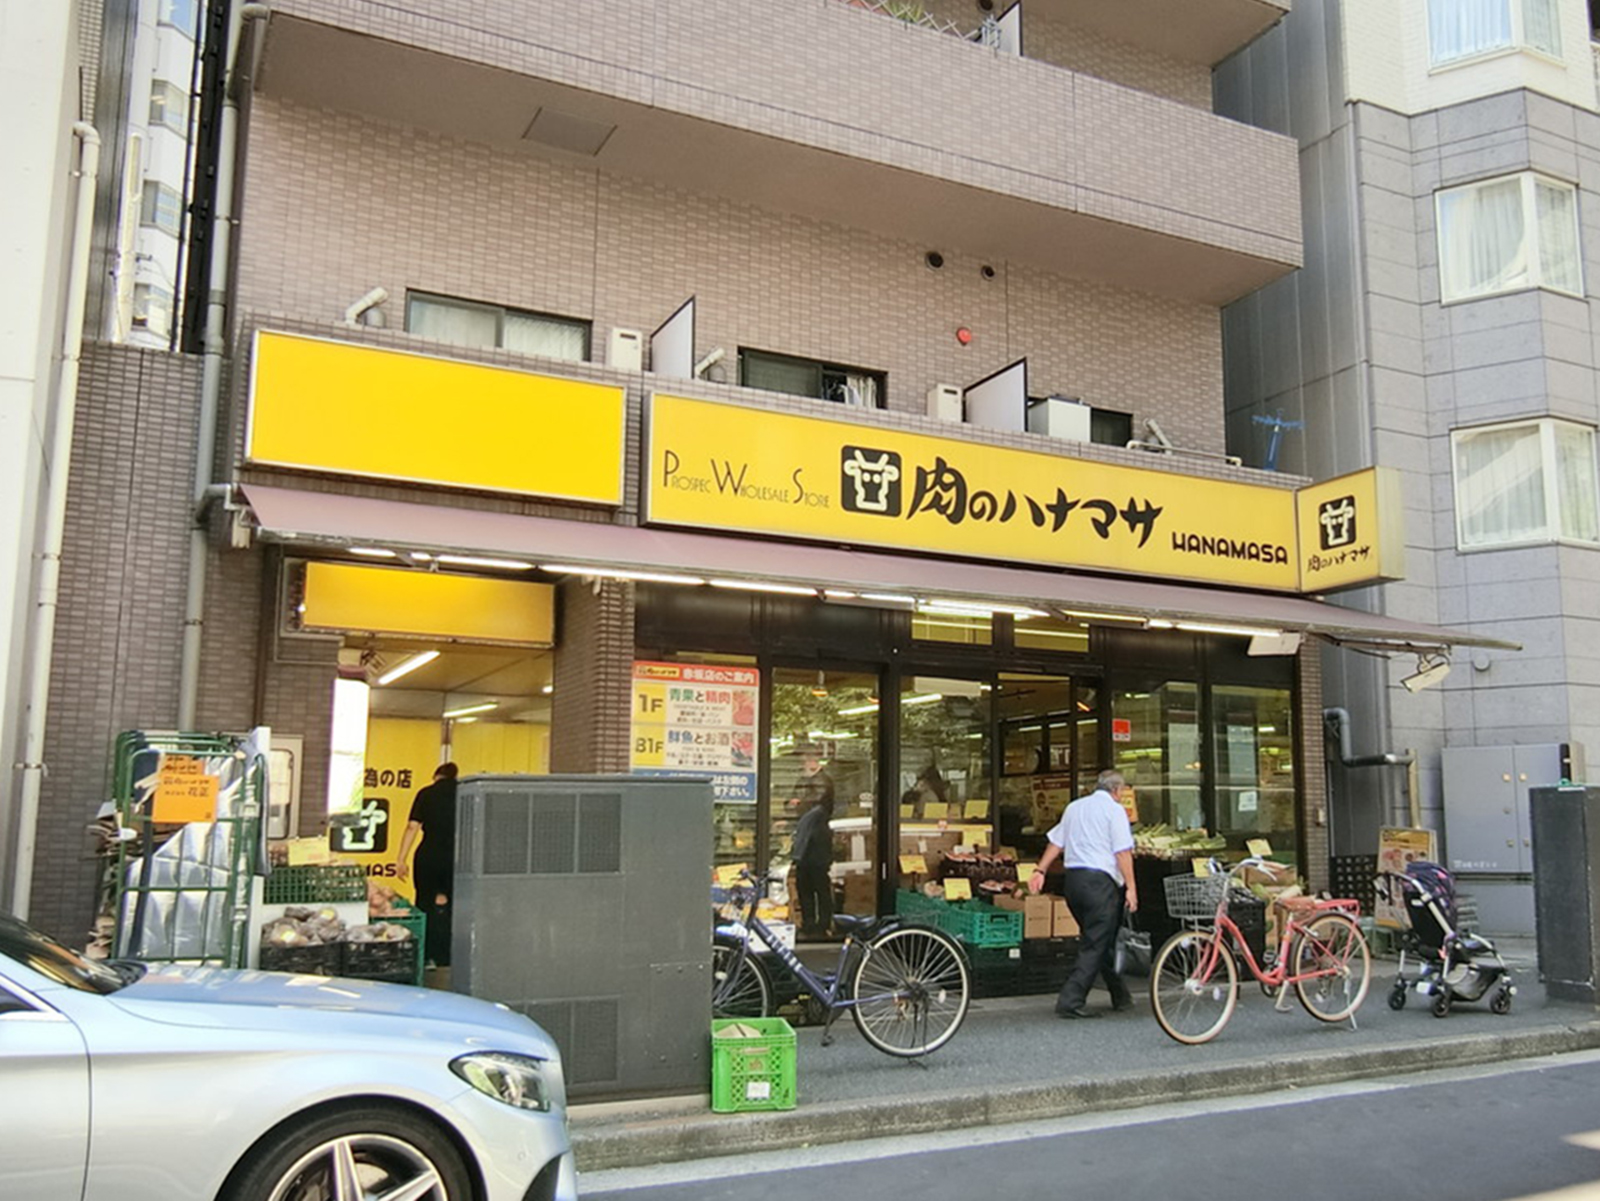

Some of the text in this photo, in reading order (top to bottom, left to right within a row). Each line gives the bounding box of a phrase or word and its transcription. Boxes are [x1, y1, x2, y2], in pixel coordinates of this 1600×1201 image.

[906, 455, 1164, 548] 肉のハナマサ
[1172, 532, 1289, 565] HANAMASA
[1307, 545, 1371, 572] 肉のハナマサ
[638, 694, 664, 713] 1F
[635, 738, 664, 754] B1F
